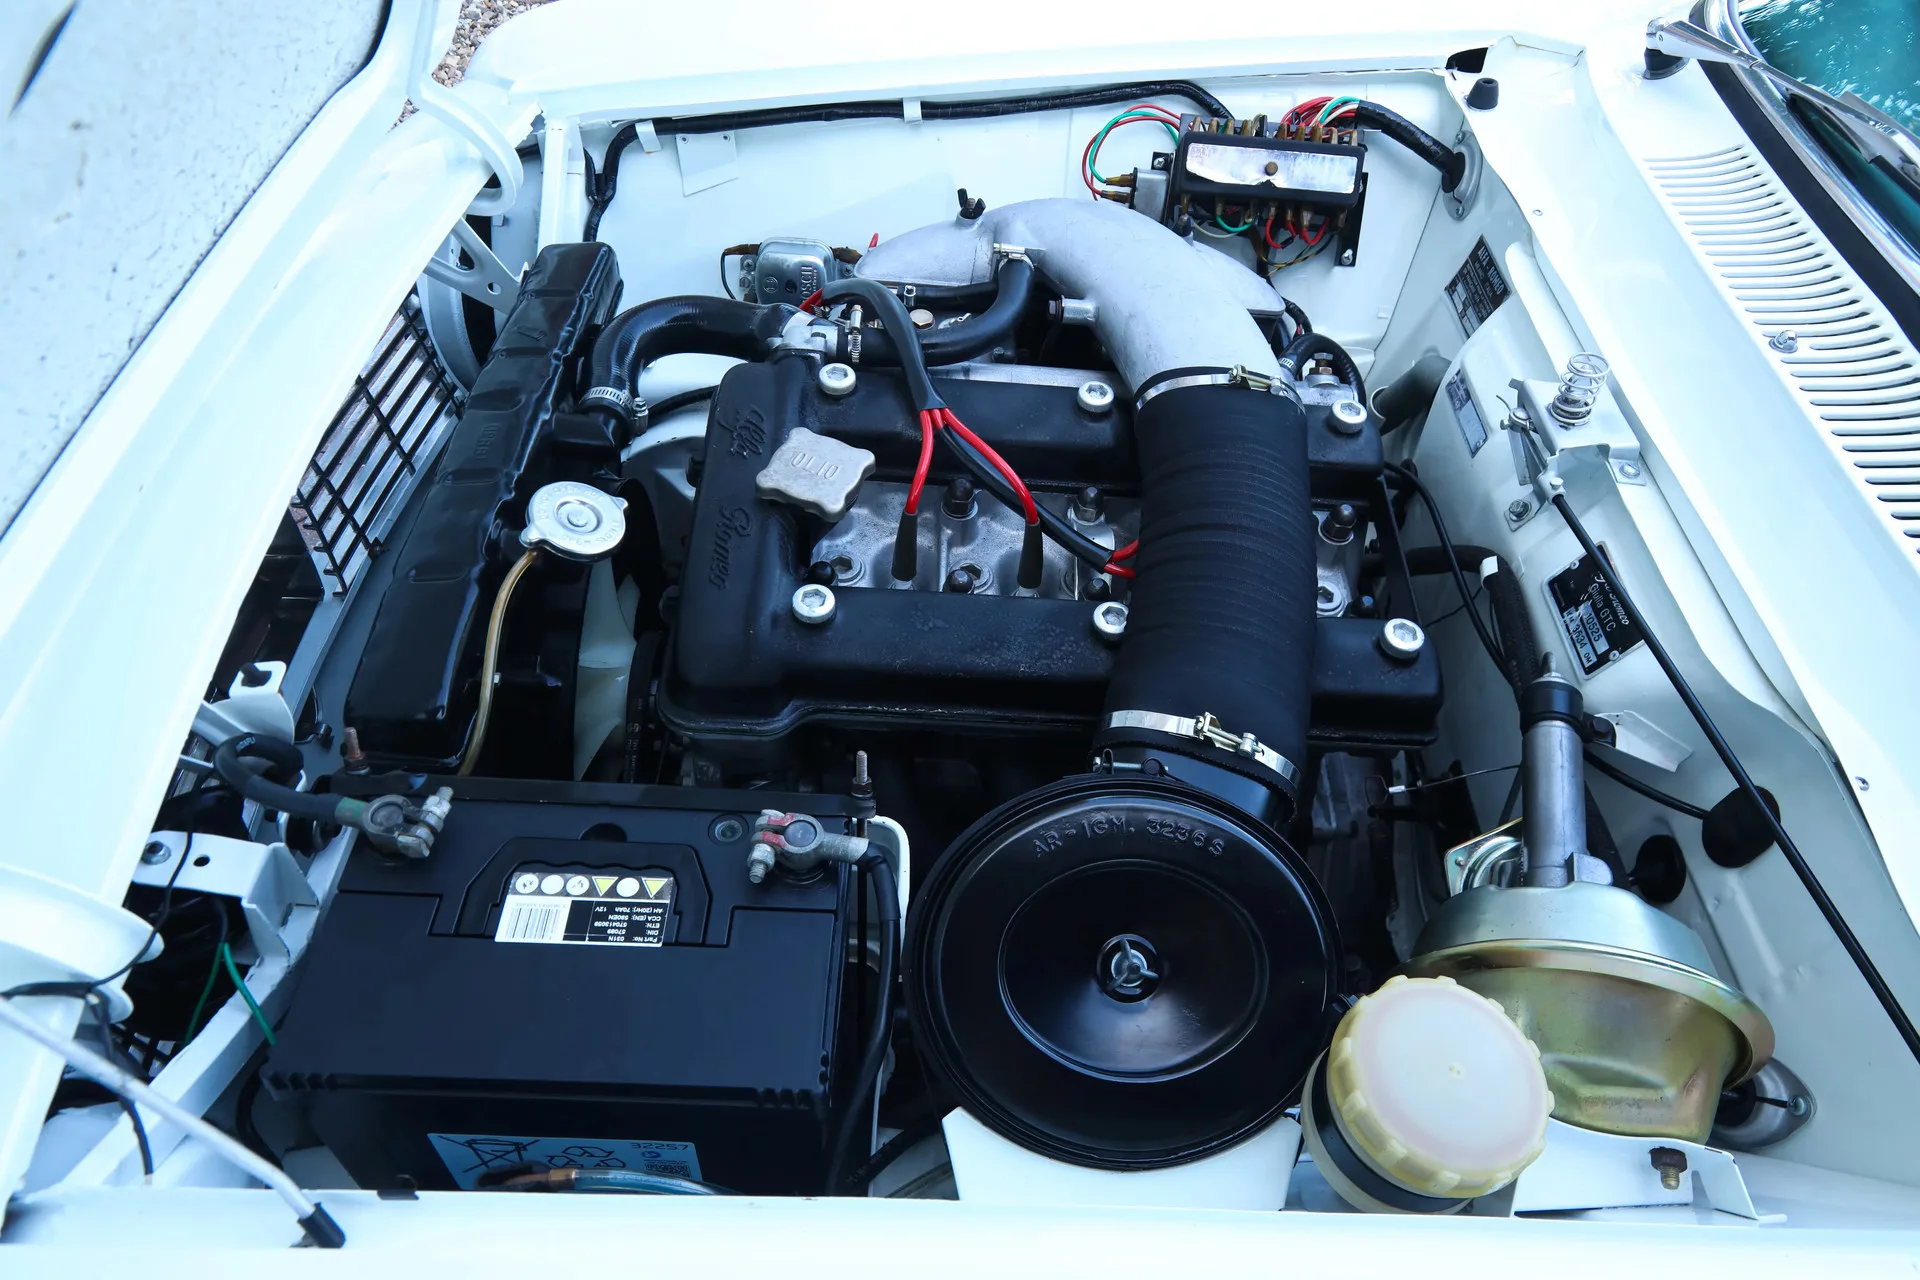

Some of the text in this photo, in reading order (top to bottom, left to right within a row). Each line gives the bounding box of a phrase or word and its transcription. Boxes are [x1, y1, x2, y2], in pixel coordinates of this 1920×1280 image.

[801, 265, 813, 303] OSCH
[1478, 246, 1490, 266] ALFA
[1487, 266, 1505, 295] ROMEO
[790, 452, 839, 480] OLIO
[709, 506, 752, 590] Romeo
[1590, 583, 1604, 609] Giulia
[1600, 608, 1616, 631] GTC
[631, 1142, 689, 1150] 32257
